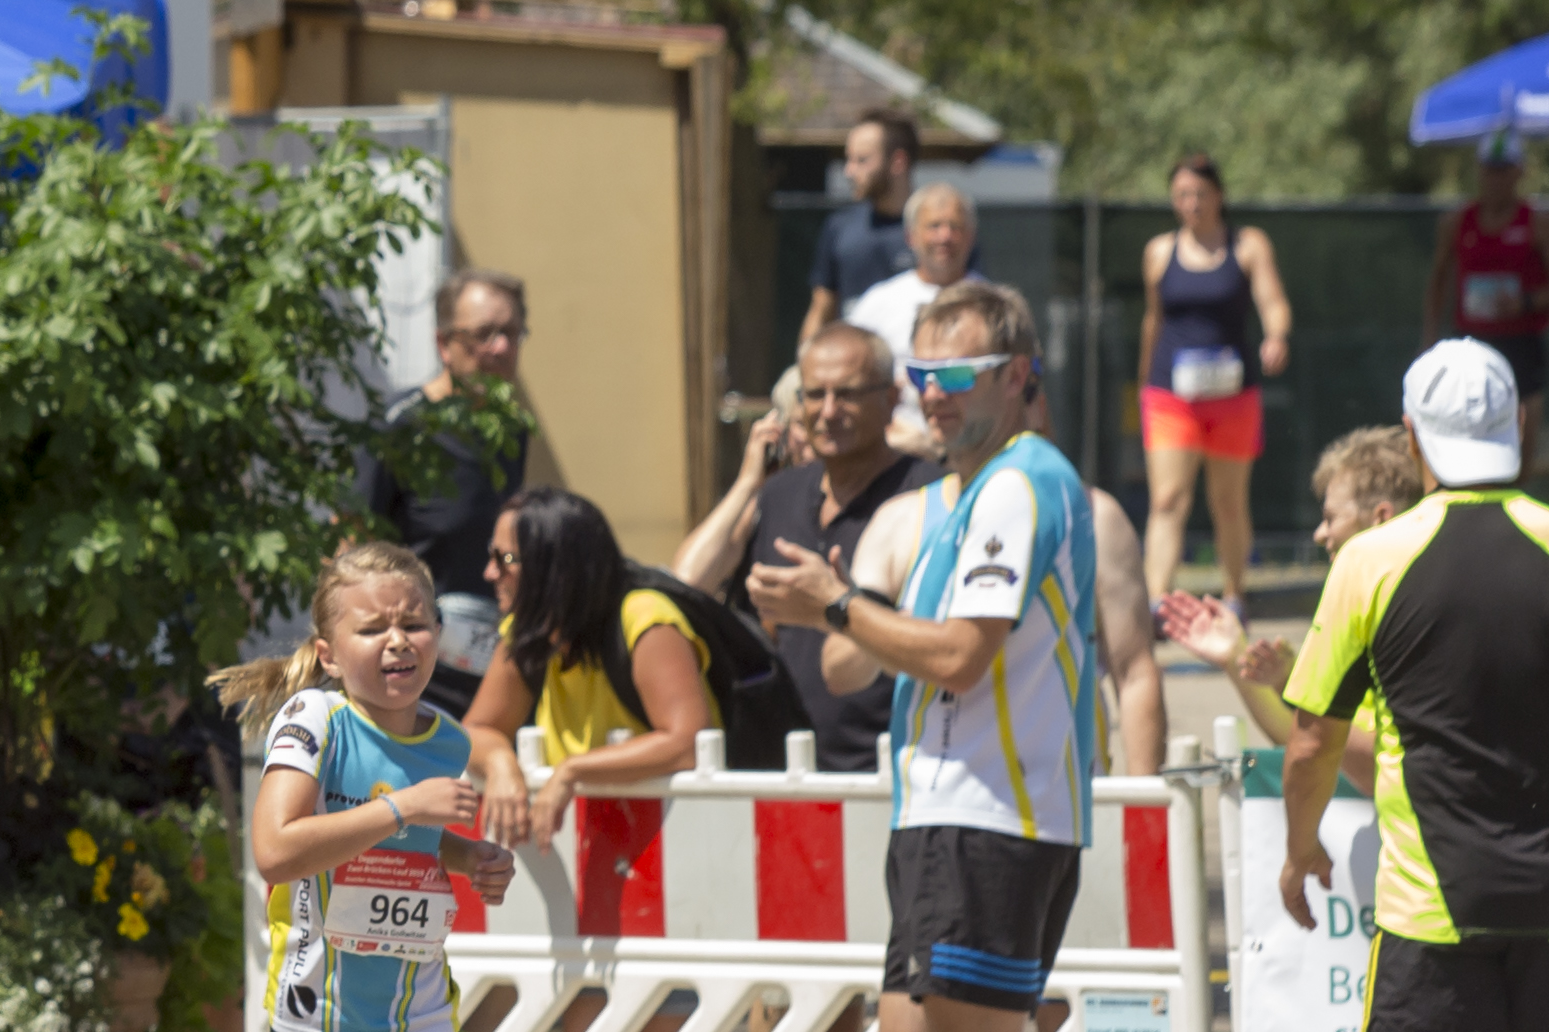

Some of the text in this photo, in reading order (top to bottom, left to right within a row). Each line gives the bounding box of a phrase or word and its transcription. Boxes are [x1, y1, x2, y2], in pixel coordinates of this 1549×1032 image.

[292, 878, 311, 978] PORT PAULI
[369, 894, 429, 928] 964
